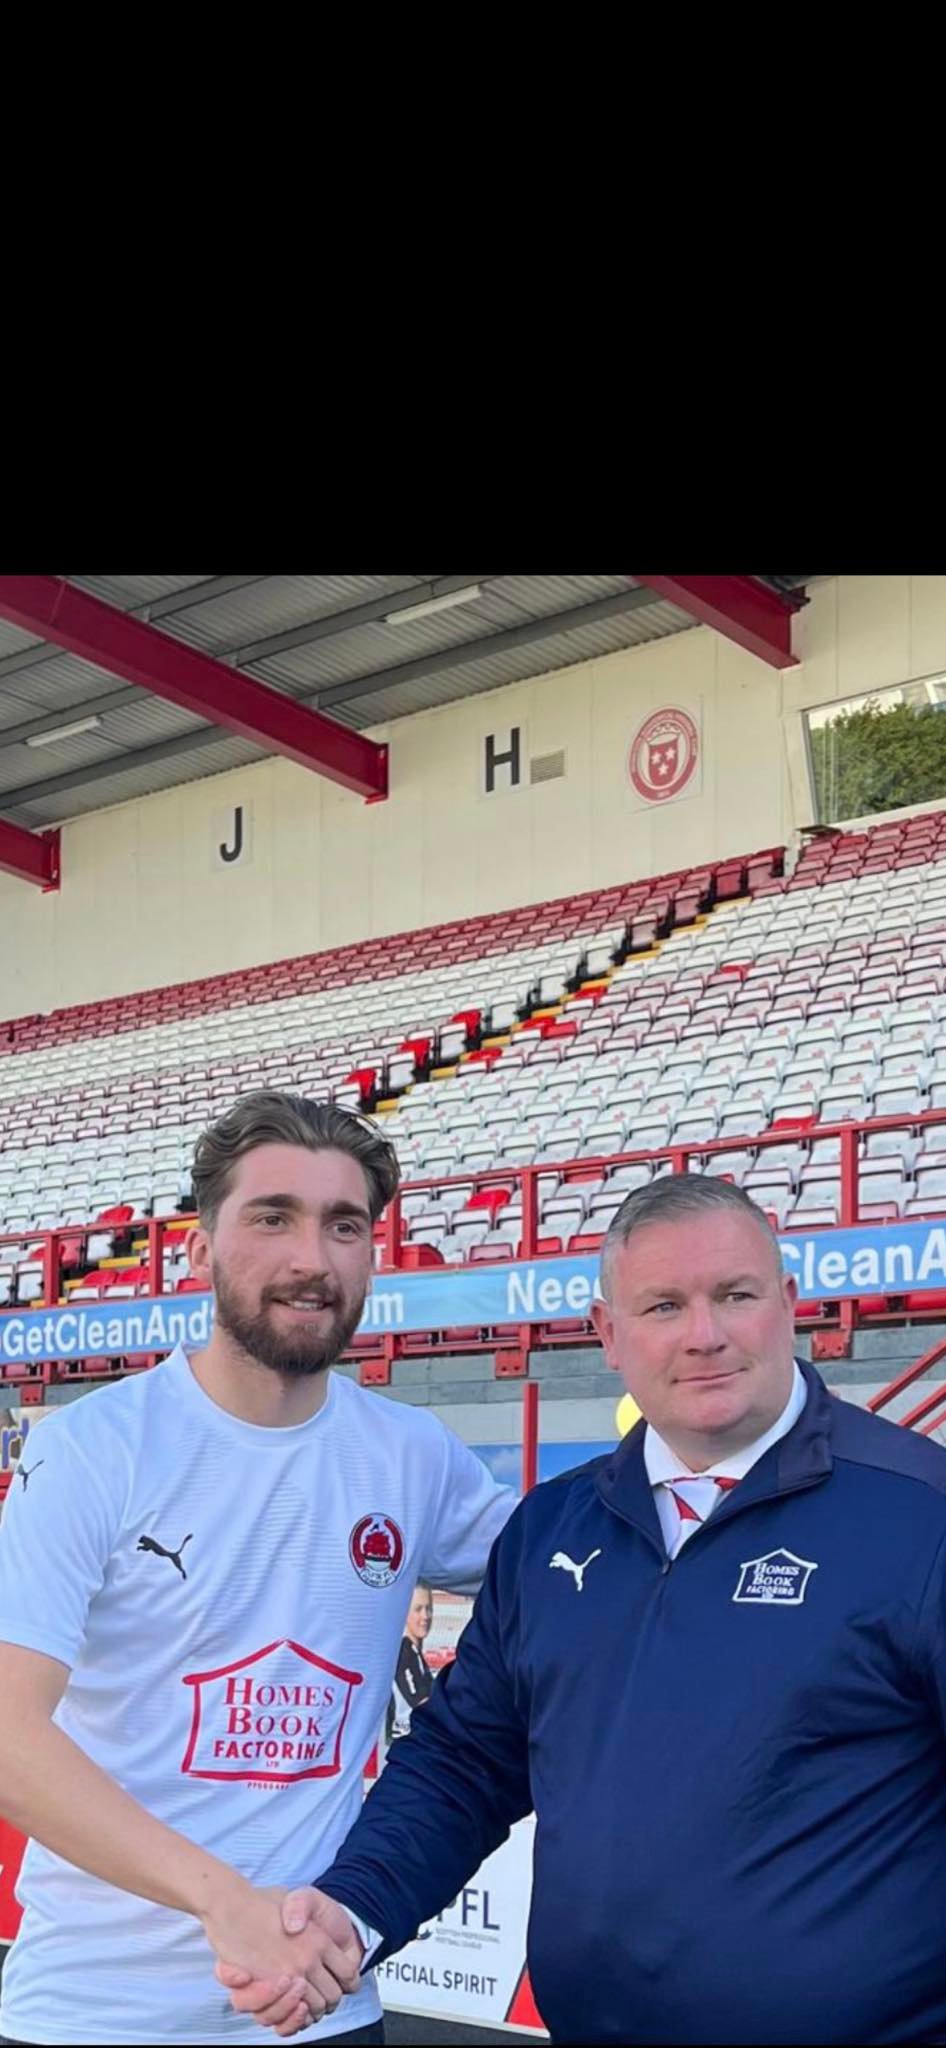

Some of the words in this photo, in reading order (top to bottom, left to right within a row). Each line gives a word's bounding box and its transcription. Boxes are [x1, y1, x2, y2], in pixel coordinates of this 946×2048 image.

[485, 726, 521, 793] H
[219, 806, 243, 862] J
[2, 1299, 215, 1357] GetCleanAnd
[752, 1575, 793, 1586] BOOK
[753, 1563, 800, 1575] HOMES
[224, 1677, 336, 1707] HOMES
[225, 1706, 322, 1737] BOOK
[442, 1969, 498, 1996] SPIRIT
